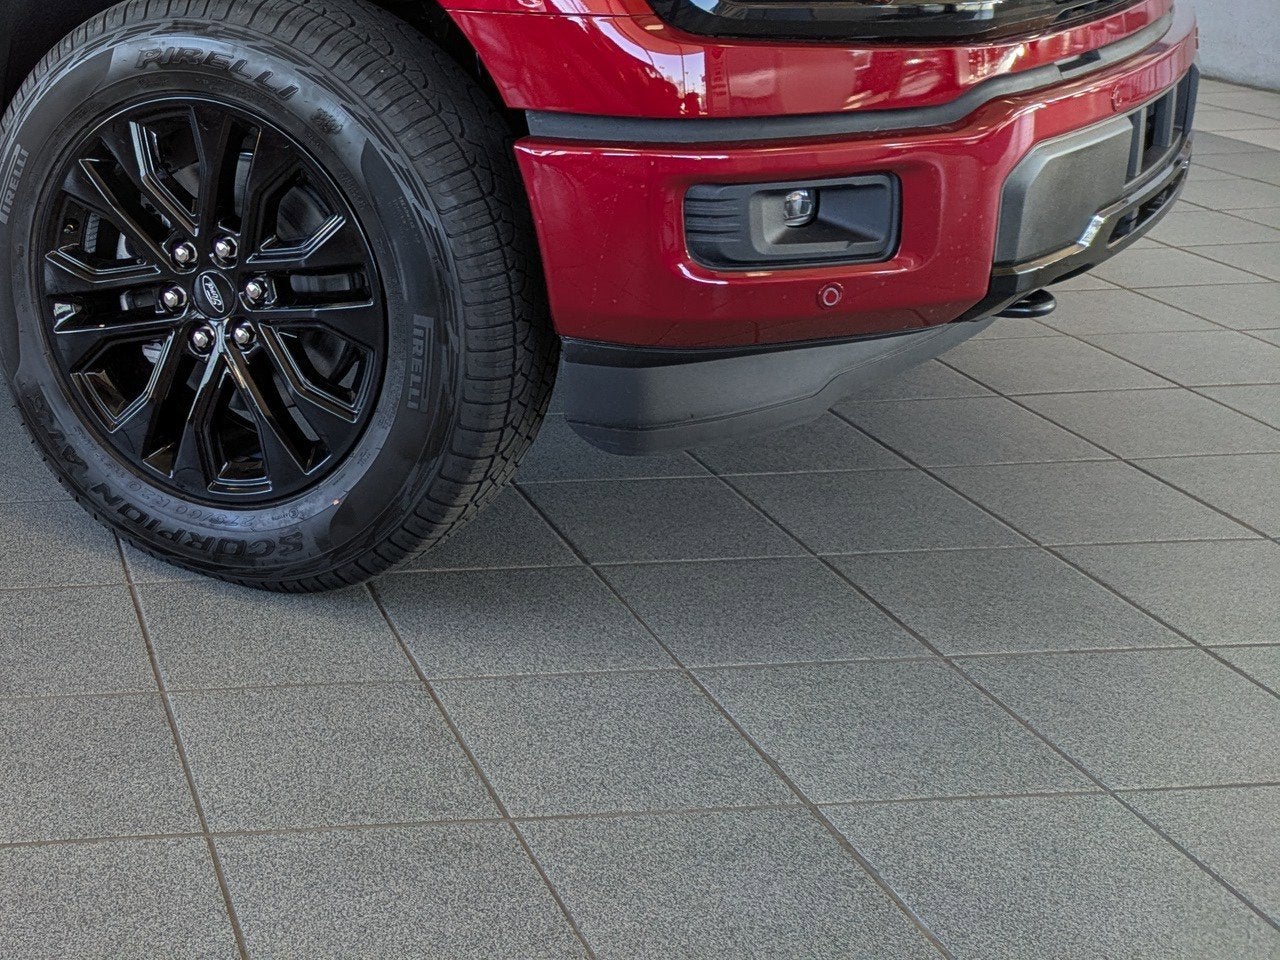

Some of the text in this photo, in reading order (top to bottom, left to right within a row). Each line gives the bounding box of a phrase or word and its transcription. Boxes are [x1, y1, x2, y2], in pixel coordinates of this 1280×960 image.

[134, 46, 300, 101] PIRELLI
[406, 313, 435, 413] PIRELLI
[90, 482, 304, 559] SCORPION
